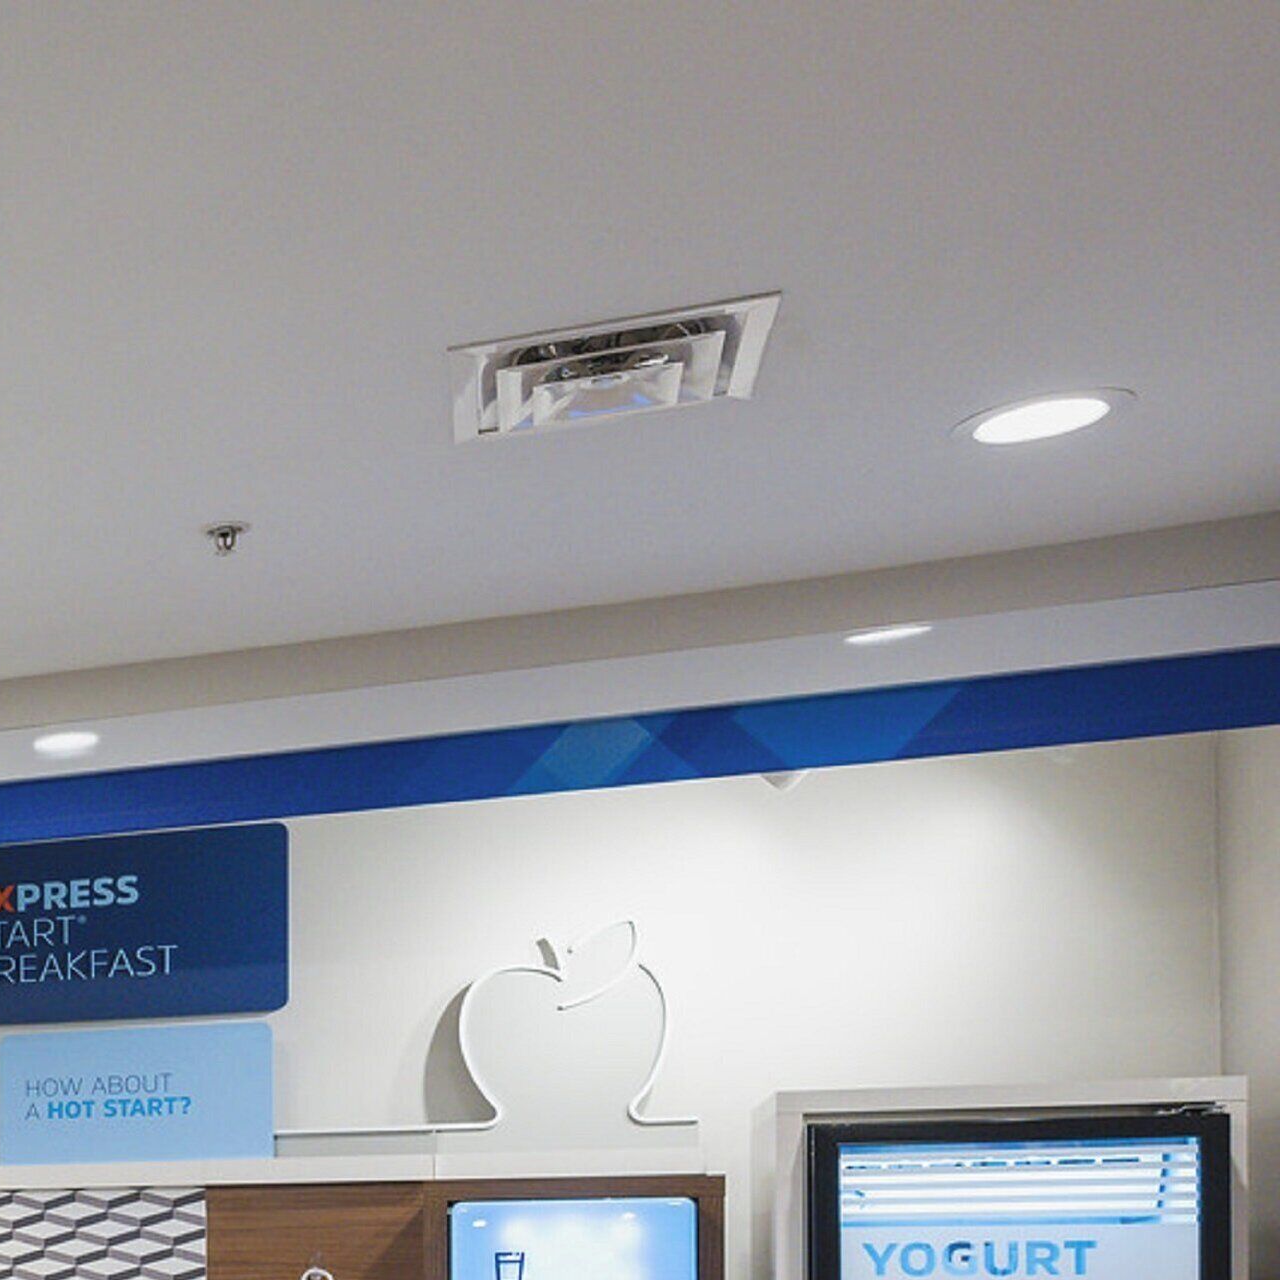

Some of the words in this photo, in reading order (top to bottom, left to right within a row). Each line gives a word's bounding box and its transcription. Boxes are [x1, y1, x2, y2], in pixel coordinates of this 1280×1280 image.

[25, 1076, 83, 1098] HOW
[91, 1072, 173, 1095] ABOUT
[24, 1103, 40, 1121] A
[47, 1100, 95, 1120] HOT
[103, 1096, 192, 1118] START?
[863, 1240, 1097, 1277] YOGURT
